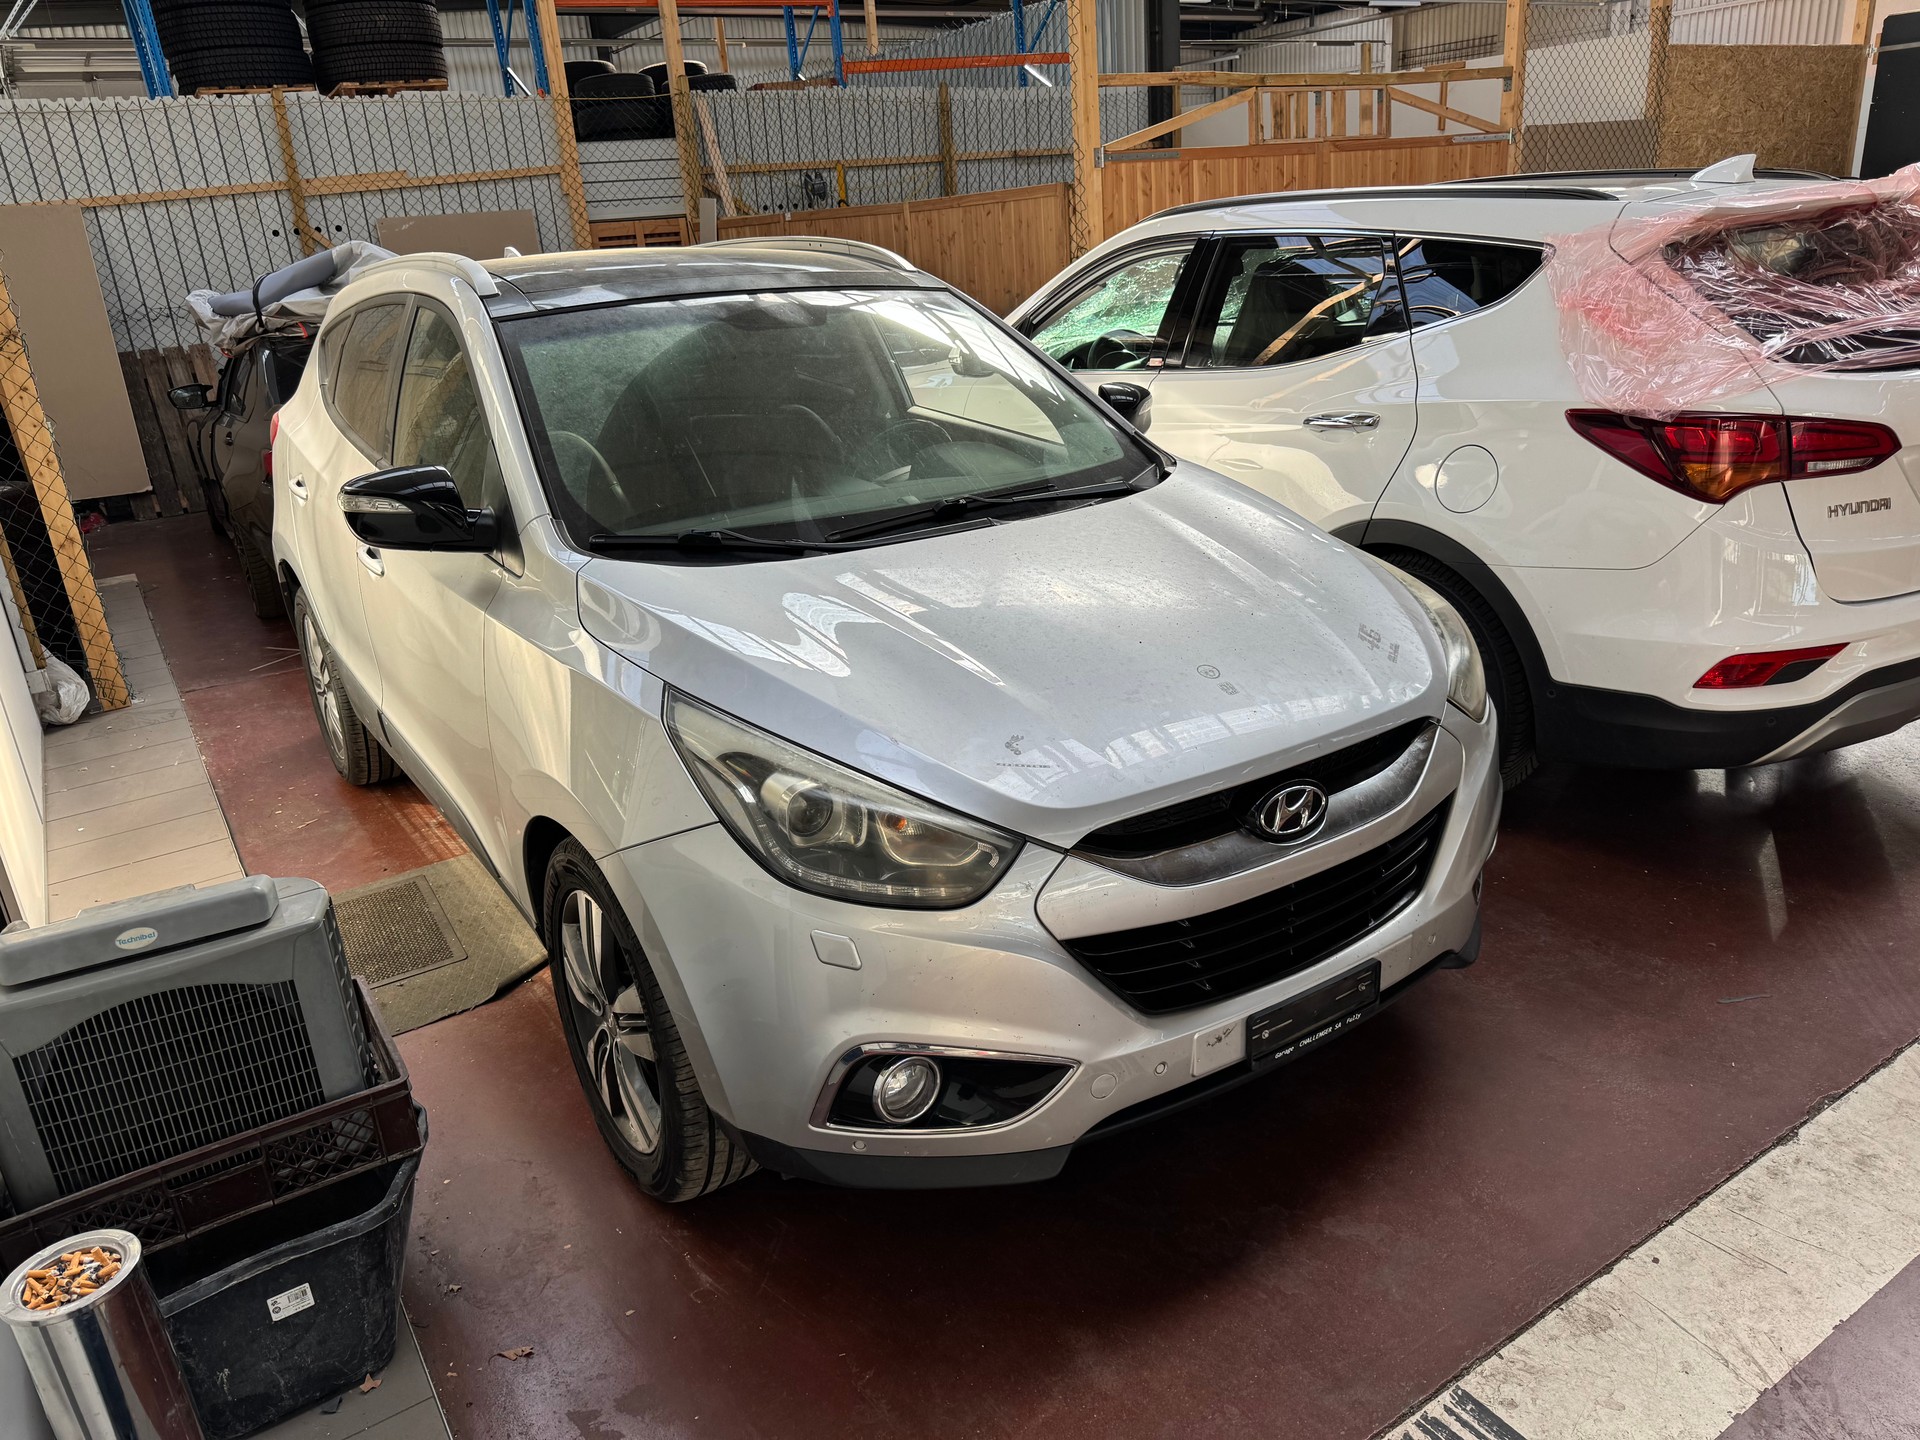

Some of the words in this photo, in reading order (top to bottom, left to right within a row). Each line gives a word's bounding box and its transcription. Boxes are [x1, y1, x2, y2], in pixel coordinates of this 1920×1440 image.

[1827, 497, 1892, 518] HYUNDAI
[116, 931, 156, 946] Technibel
[1274, 1046, 1295, 1059] Garage
[1299, 1026, 1333, 1048] CHALLENGER
[1334, 1022, 1342, 1030] SA
